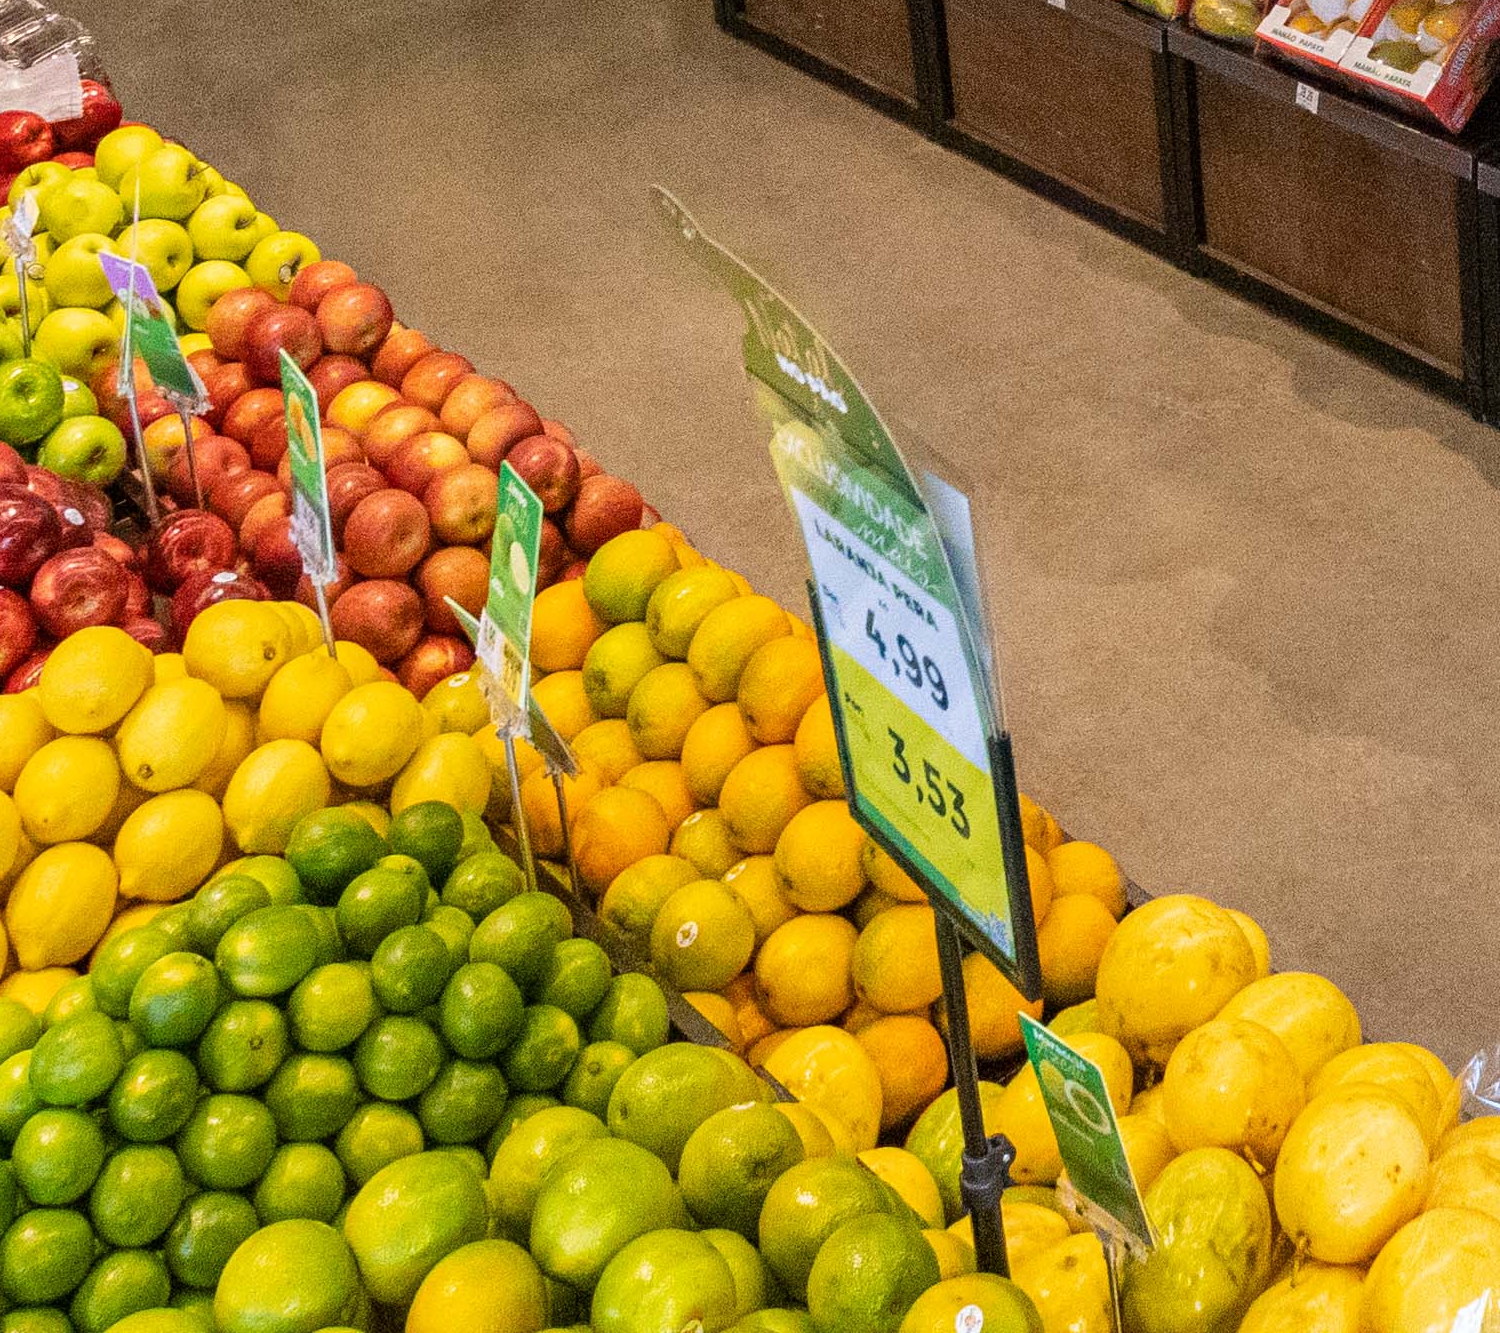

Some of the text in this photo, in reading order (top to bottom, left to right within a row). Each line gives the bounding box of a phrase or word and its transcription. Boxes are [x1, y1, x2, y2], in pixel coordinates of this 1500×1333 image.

[1353, 61, 1413, 90] MAMÃO PAPAYA
[813, 518, 939, 632] LARANJA PERA
[865, 608, 949, 712] 4,99
[887, 726, 971, 841] 3,53
